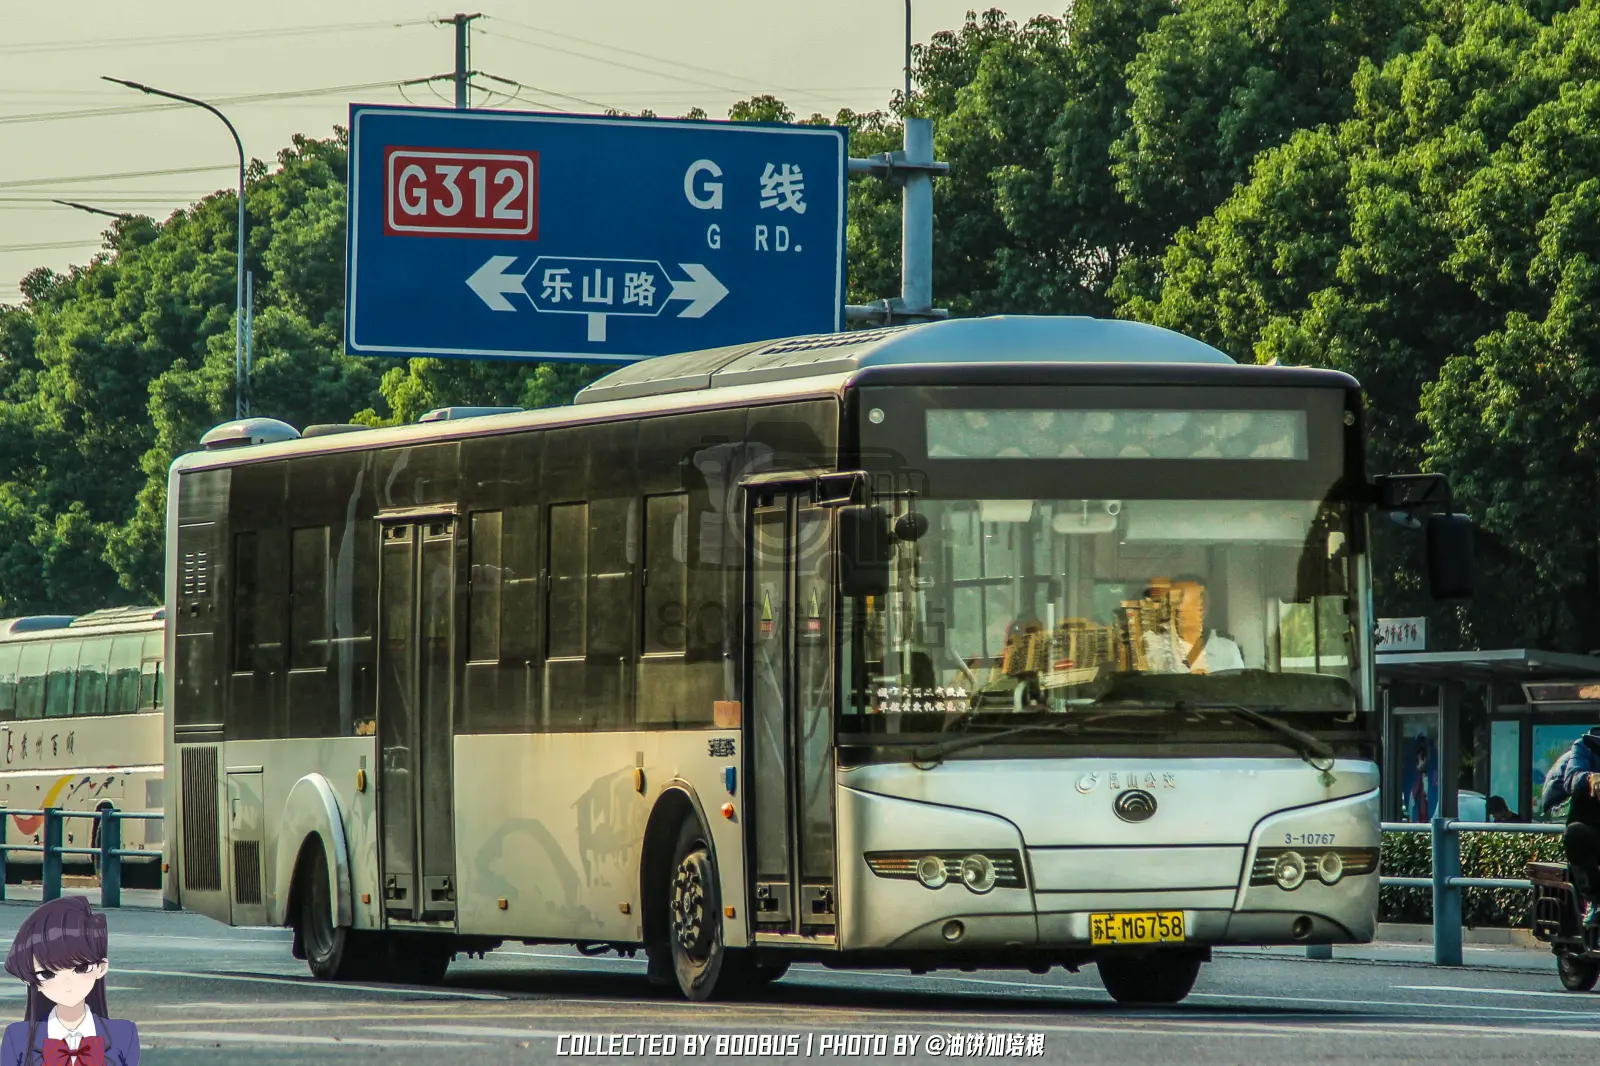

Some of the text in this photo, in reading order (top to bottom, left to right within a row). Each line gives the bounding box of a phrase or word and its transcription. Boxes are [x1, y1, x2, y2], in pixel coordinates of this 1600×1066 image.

[398, 164, 524, 220] G312
[683, 158, 807, 214] G 线
[706, 223, 802, 252] G RD.
[540, 267, 657, 307] 乐山路
[1109, 771, 1176, 789] 昆山公交
[1284, 833, 1336, 845] 3-10767
